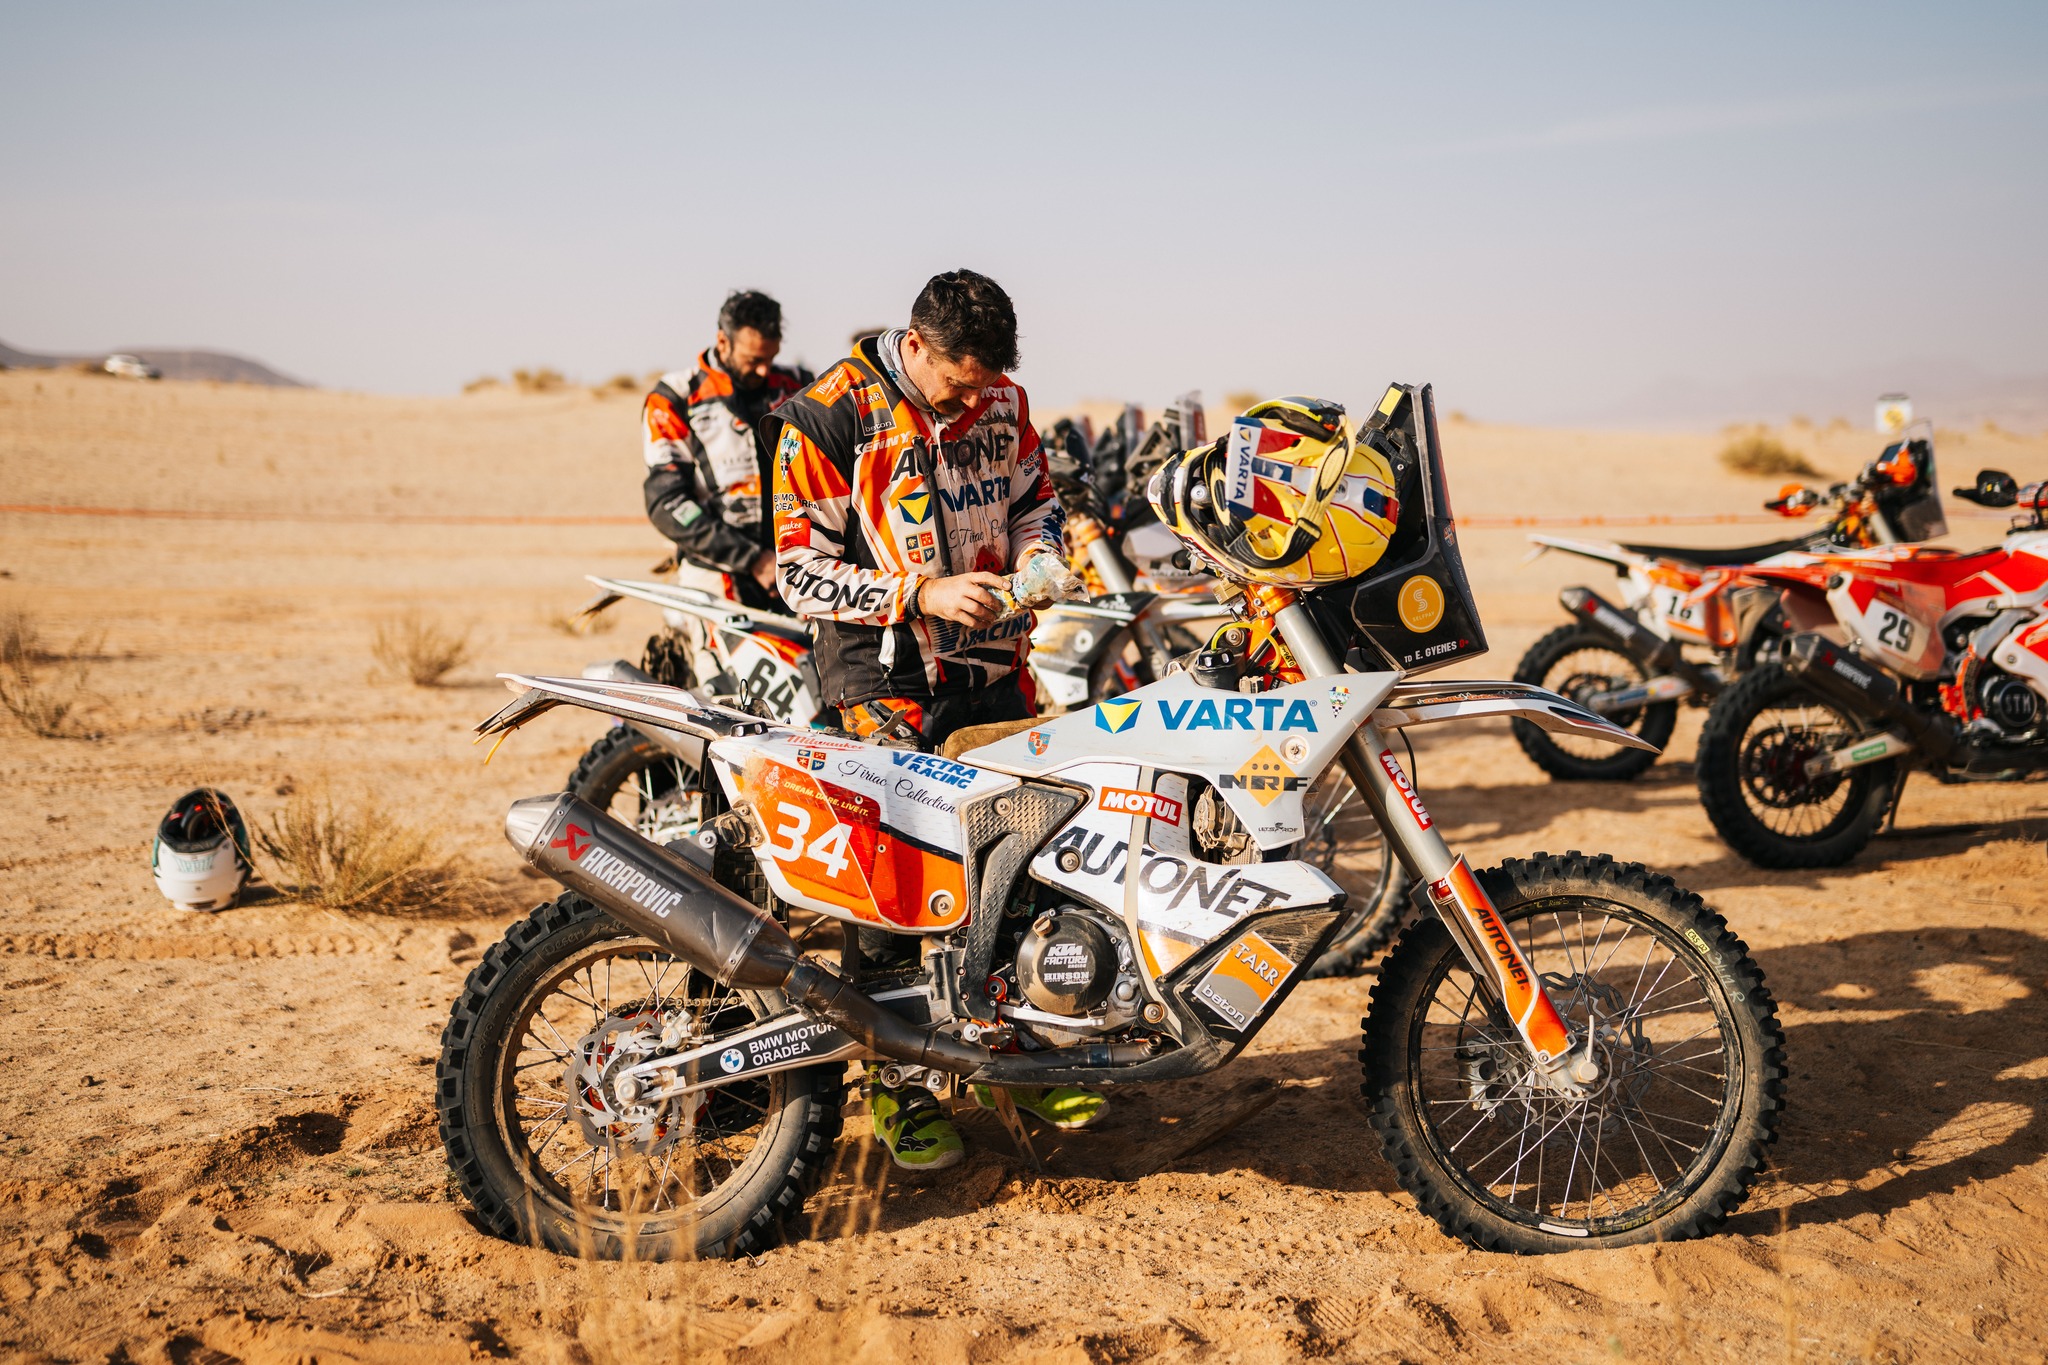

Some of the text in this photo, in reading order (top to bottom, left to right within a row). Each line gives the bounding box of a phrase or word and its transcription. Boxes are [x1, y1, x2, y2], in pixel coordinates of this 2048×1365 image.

[854, 430, 912, 455] KENNY
[1233, 445, 1250, 500] VARTA
[938, 476, 1011, 513] VARTA
[1878, 611, 1914, 652] 29
[1425, 641, 1458, 658] GYENES
[750, 657, 804, 720] 64
[1157, 699, 1319, 733] VARTA
[787, 735, 864, 750] Milwaukee
[892, 752, 979, 780] VECTRA
[907, 763, 973, 790] RACING
[783, 781, 815, 798] DREAM.
[815, 792, 840, 807] DARE.
[840, 801, 860, 814] LIVE
[838, 759, 957, 814] Tiriac Collection
[1219, 774, 1308, 791] NRF
[1382, 754, 1431, 826] MOTUL
[1102, 791, 1179, 822] MOTUL
[770, 801, 853, 879] 34
[1041, 825, 1292, 918] AUTONET
[543, 927, 587, 955] Desert
[1047, 943, 1083, 957] KTM
[1471, 907, 1530, 987] AUTONET
[1687, 931, 1701, 944] CAS
[1043, 955, 1088, 966] FACTORY
[1043, 971, 1090, 981] HINSON
[1233, 942, 1279, 987] TARR
[1200, 983, 1247, 1024] beton
[748, 1033, 785, 1055] BMW
[752, 1041, 811, 1067] ORADEA
